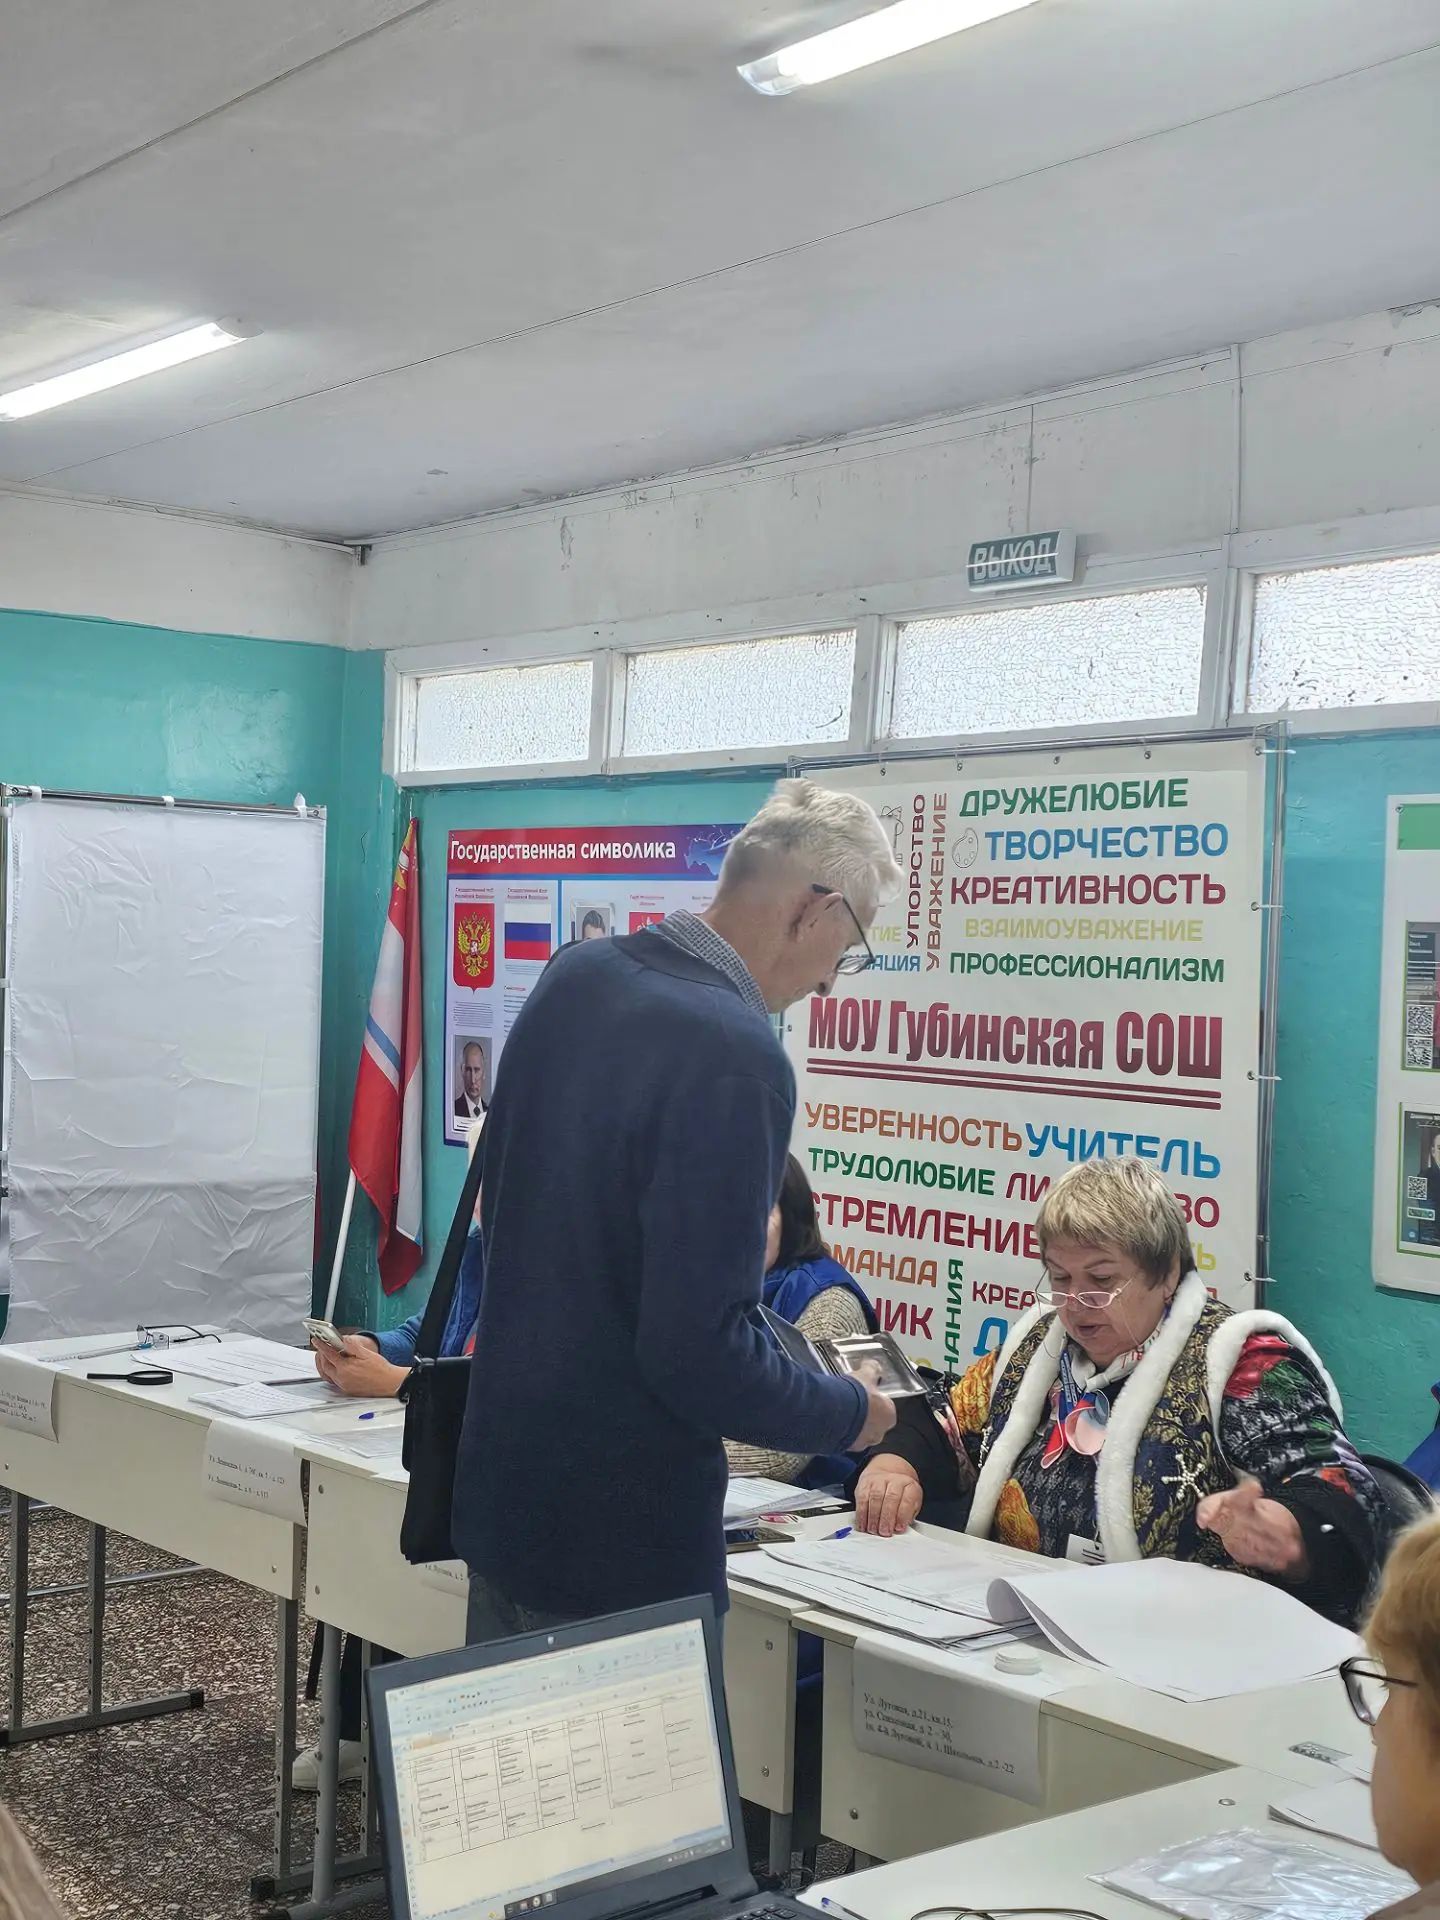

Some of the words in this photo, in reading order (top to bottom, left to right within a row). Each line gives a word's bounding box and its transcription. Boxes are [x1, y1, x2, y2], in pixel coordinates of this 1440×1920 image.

[973, 537, 1052, 581] ВЫХОД
[959, 777, 1189, 818] ДРУЖЕЛЮБИЕ
[451, 840, 576, 863] Государственная
[581, 841, 676, 859] символика
[984, 822, 1229, 862] ТВОРЧЕСТВО
[907, 794, 926, 949] УПОРСТВО
[926, 792, 948, 972] УВАЖЕНИЕ
[950, 873, 1226, 906] КРЕАТИВНОСТЬ
[965, 918, 1204, 943] ВЗАИМОУВАЖЕНИЕ
[950, 952, 1225, 983] ПРОФЕССИОНАЛИЗМ
[808, 996, 882, 1052] МОУ
[888, 1000, 1105, 1071] Губинская
[1115, 1011, 1223, 1080] СОШ
[804, 1102, 1023, 1153] УВЕРЕННОСТЬ
[808, 1147, 997, 1197] ТРУДОЛЮБИЕ
[1025, 1123, 1221, 1179] УЧИТЕЛЬ
